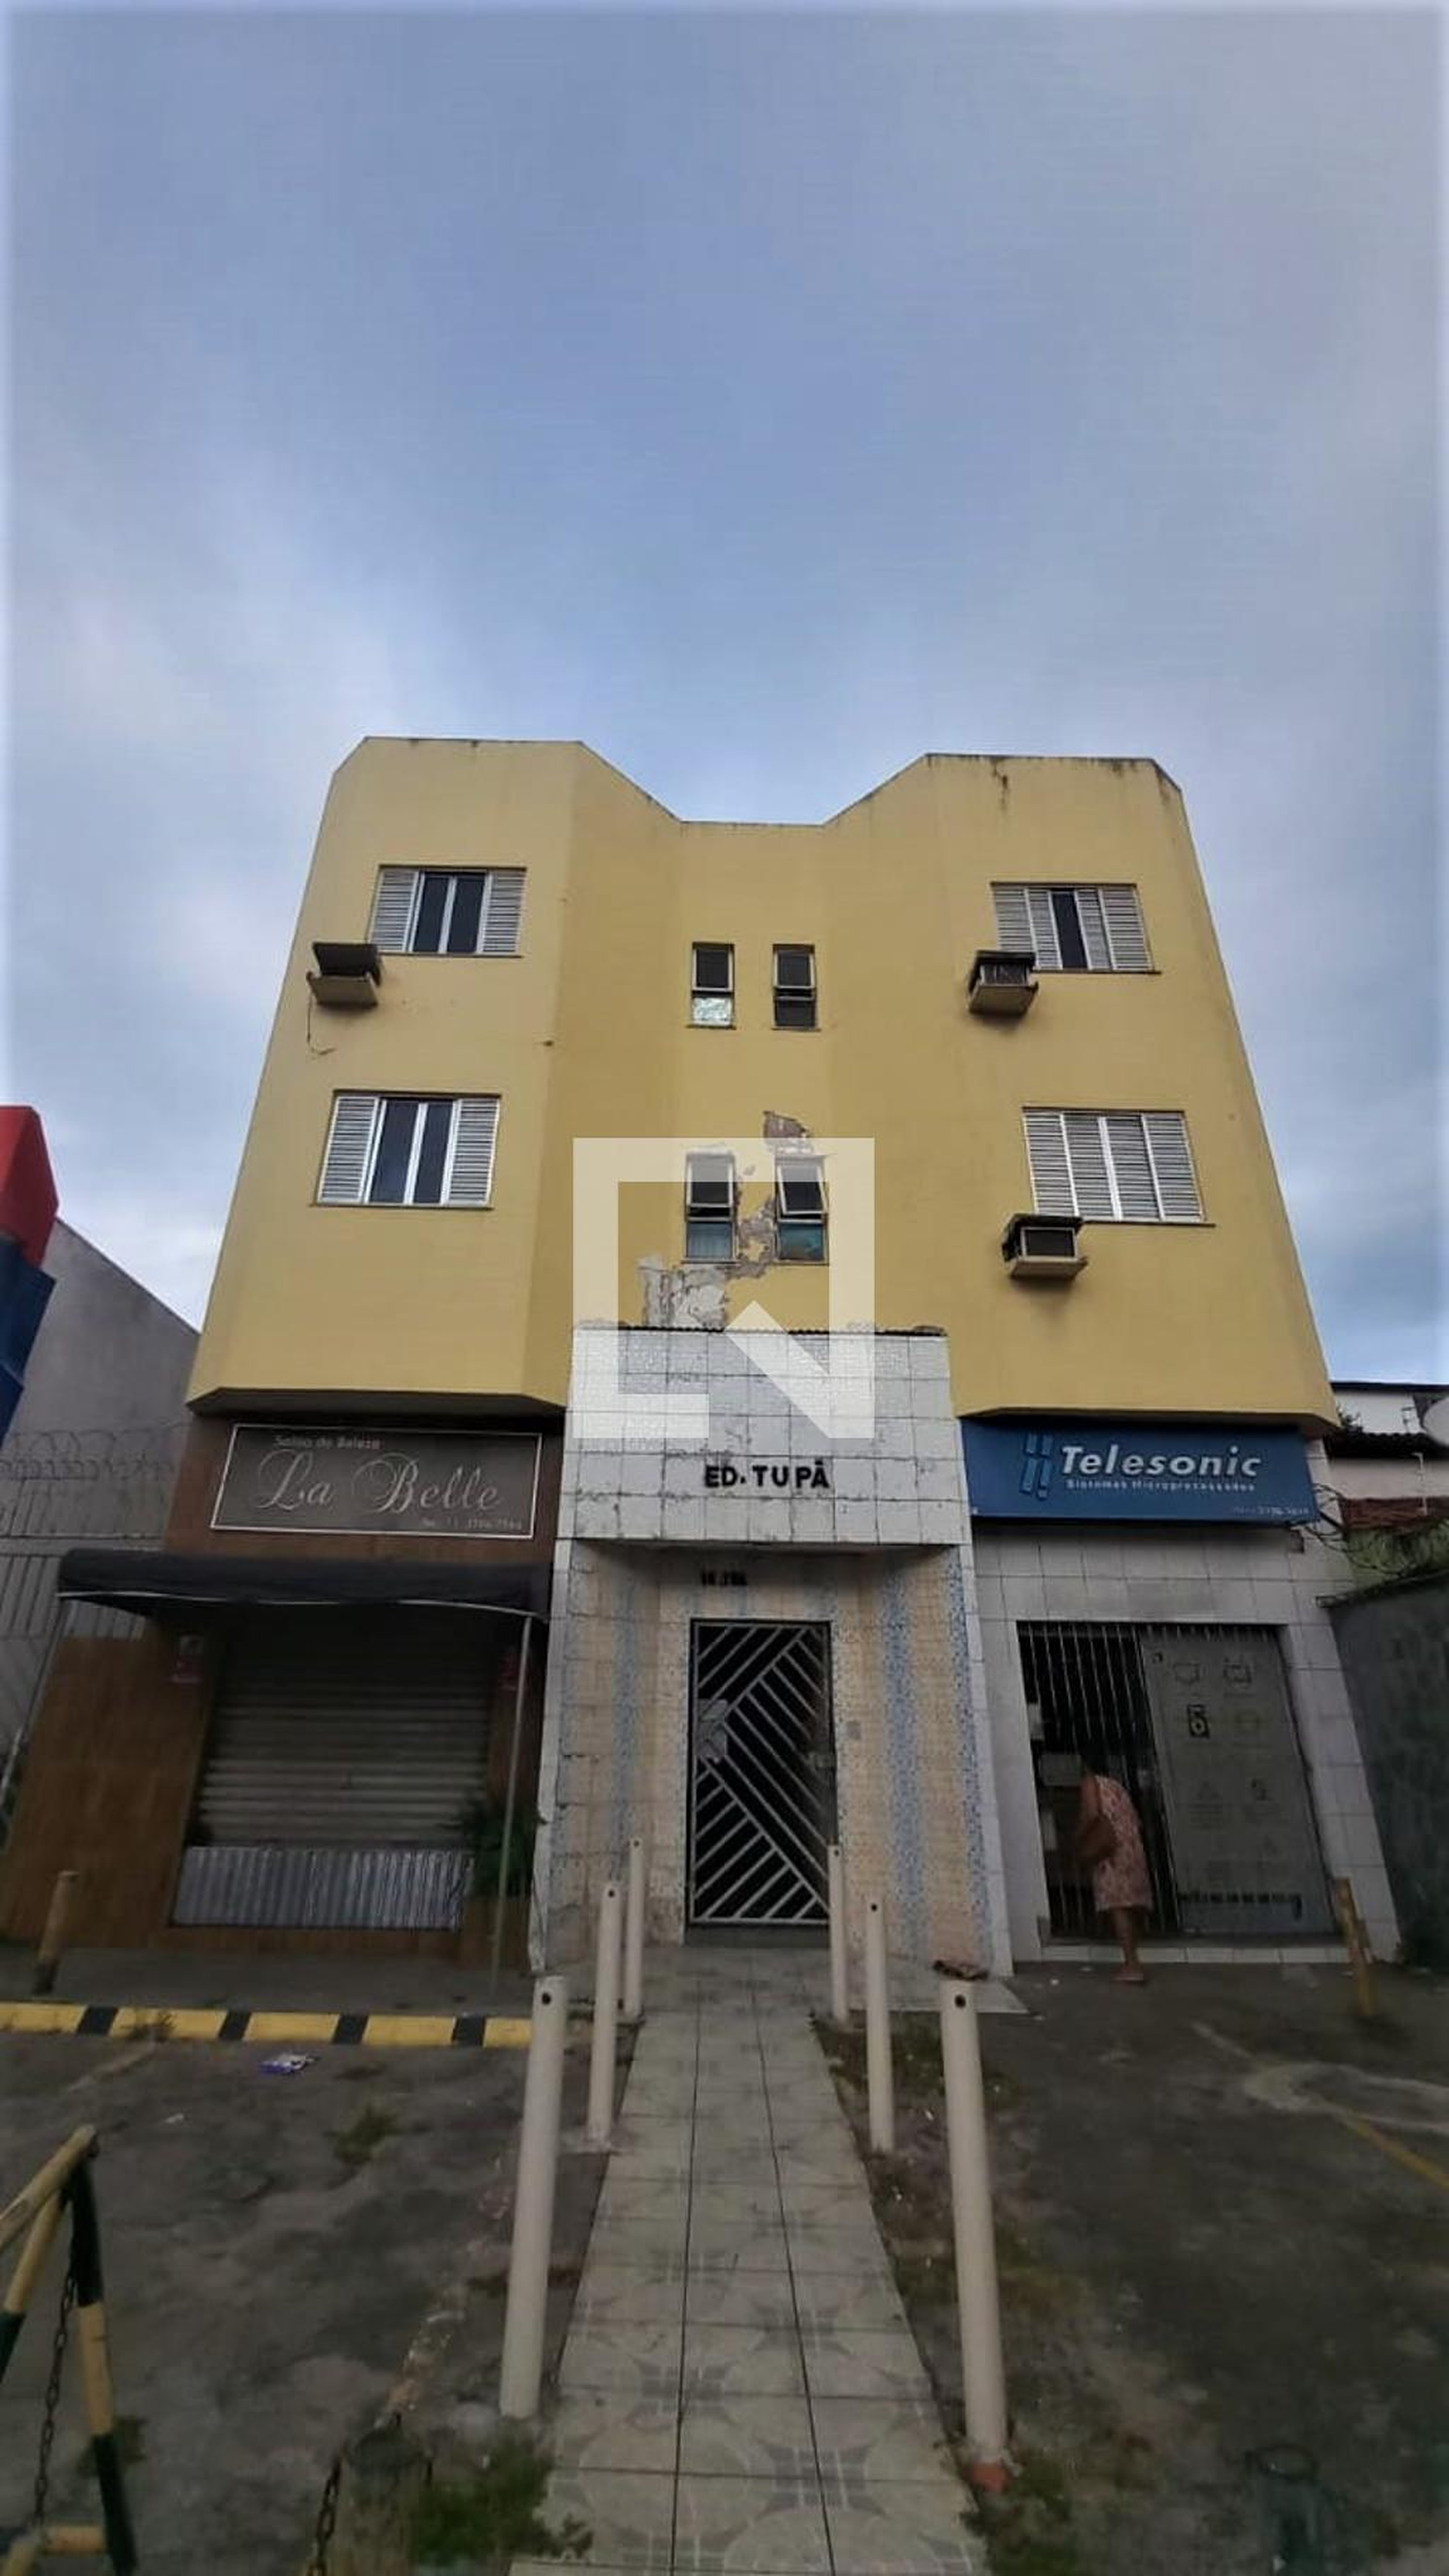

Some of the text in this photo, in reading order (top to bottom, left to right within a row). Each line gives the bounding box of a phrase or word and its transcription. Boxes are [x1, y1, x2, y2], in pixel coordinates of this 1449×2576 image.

[705, 1459, 829, 1488] ED. TUPÃ
[1062, 1444, 1261, 1476] Telesonic
[257, 1448, 501, 1513] La Belle
